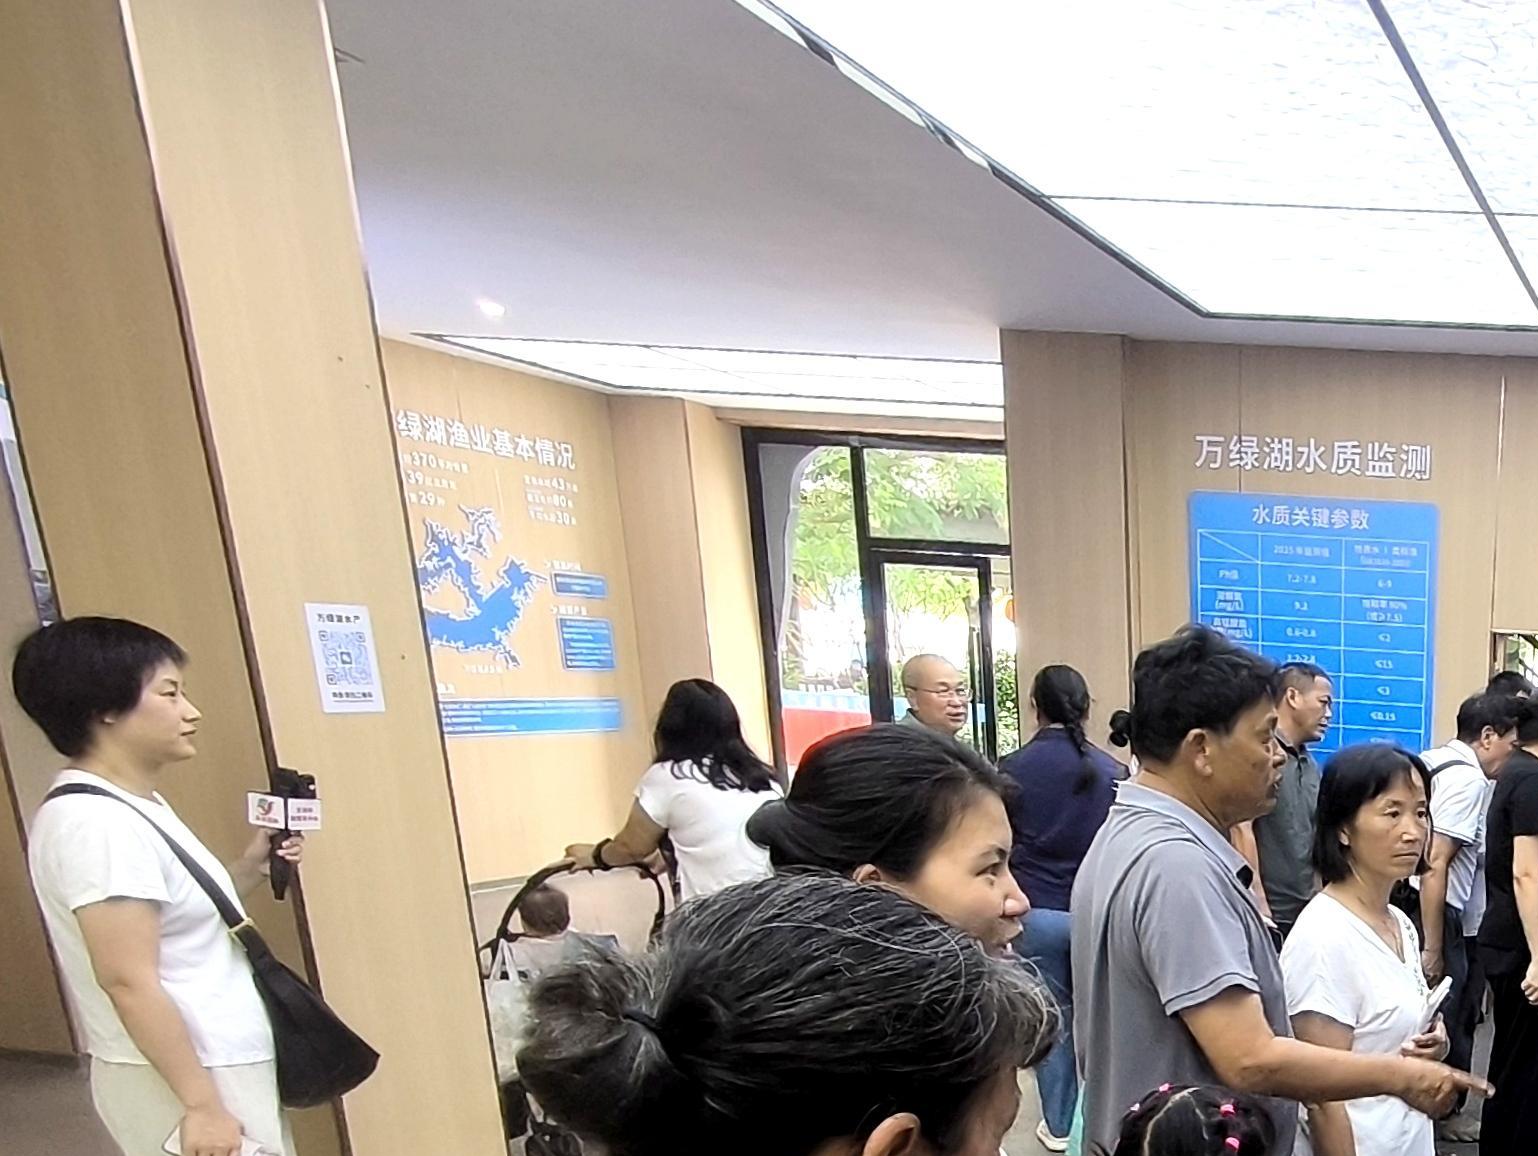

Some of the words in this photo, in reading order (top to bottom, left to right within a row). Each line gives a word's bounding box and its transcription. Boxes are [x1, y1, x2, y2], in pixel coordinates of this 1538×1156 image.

[1195, 434, 1432, 480] 万绿湖水质监测
[1252, 504, 1370, 530] 水质关键参数
